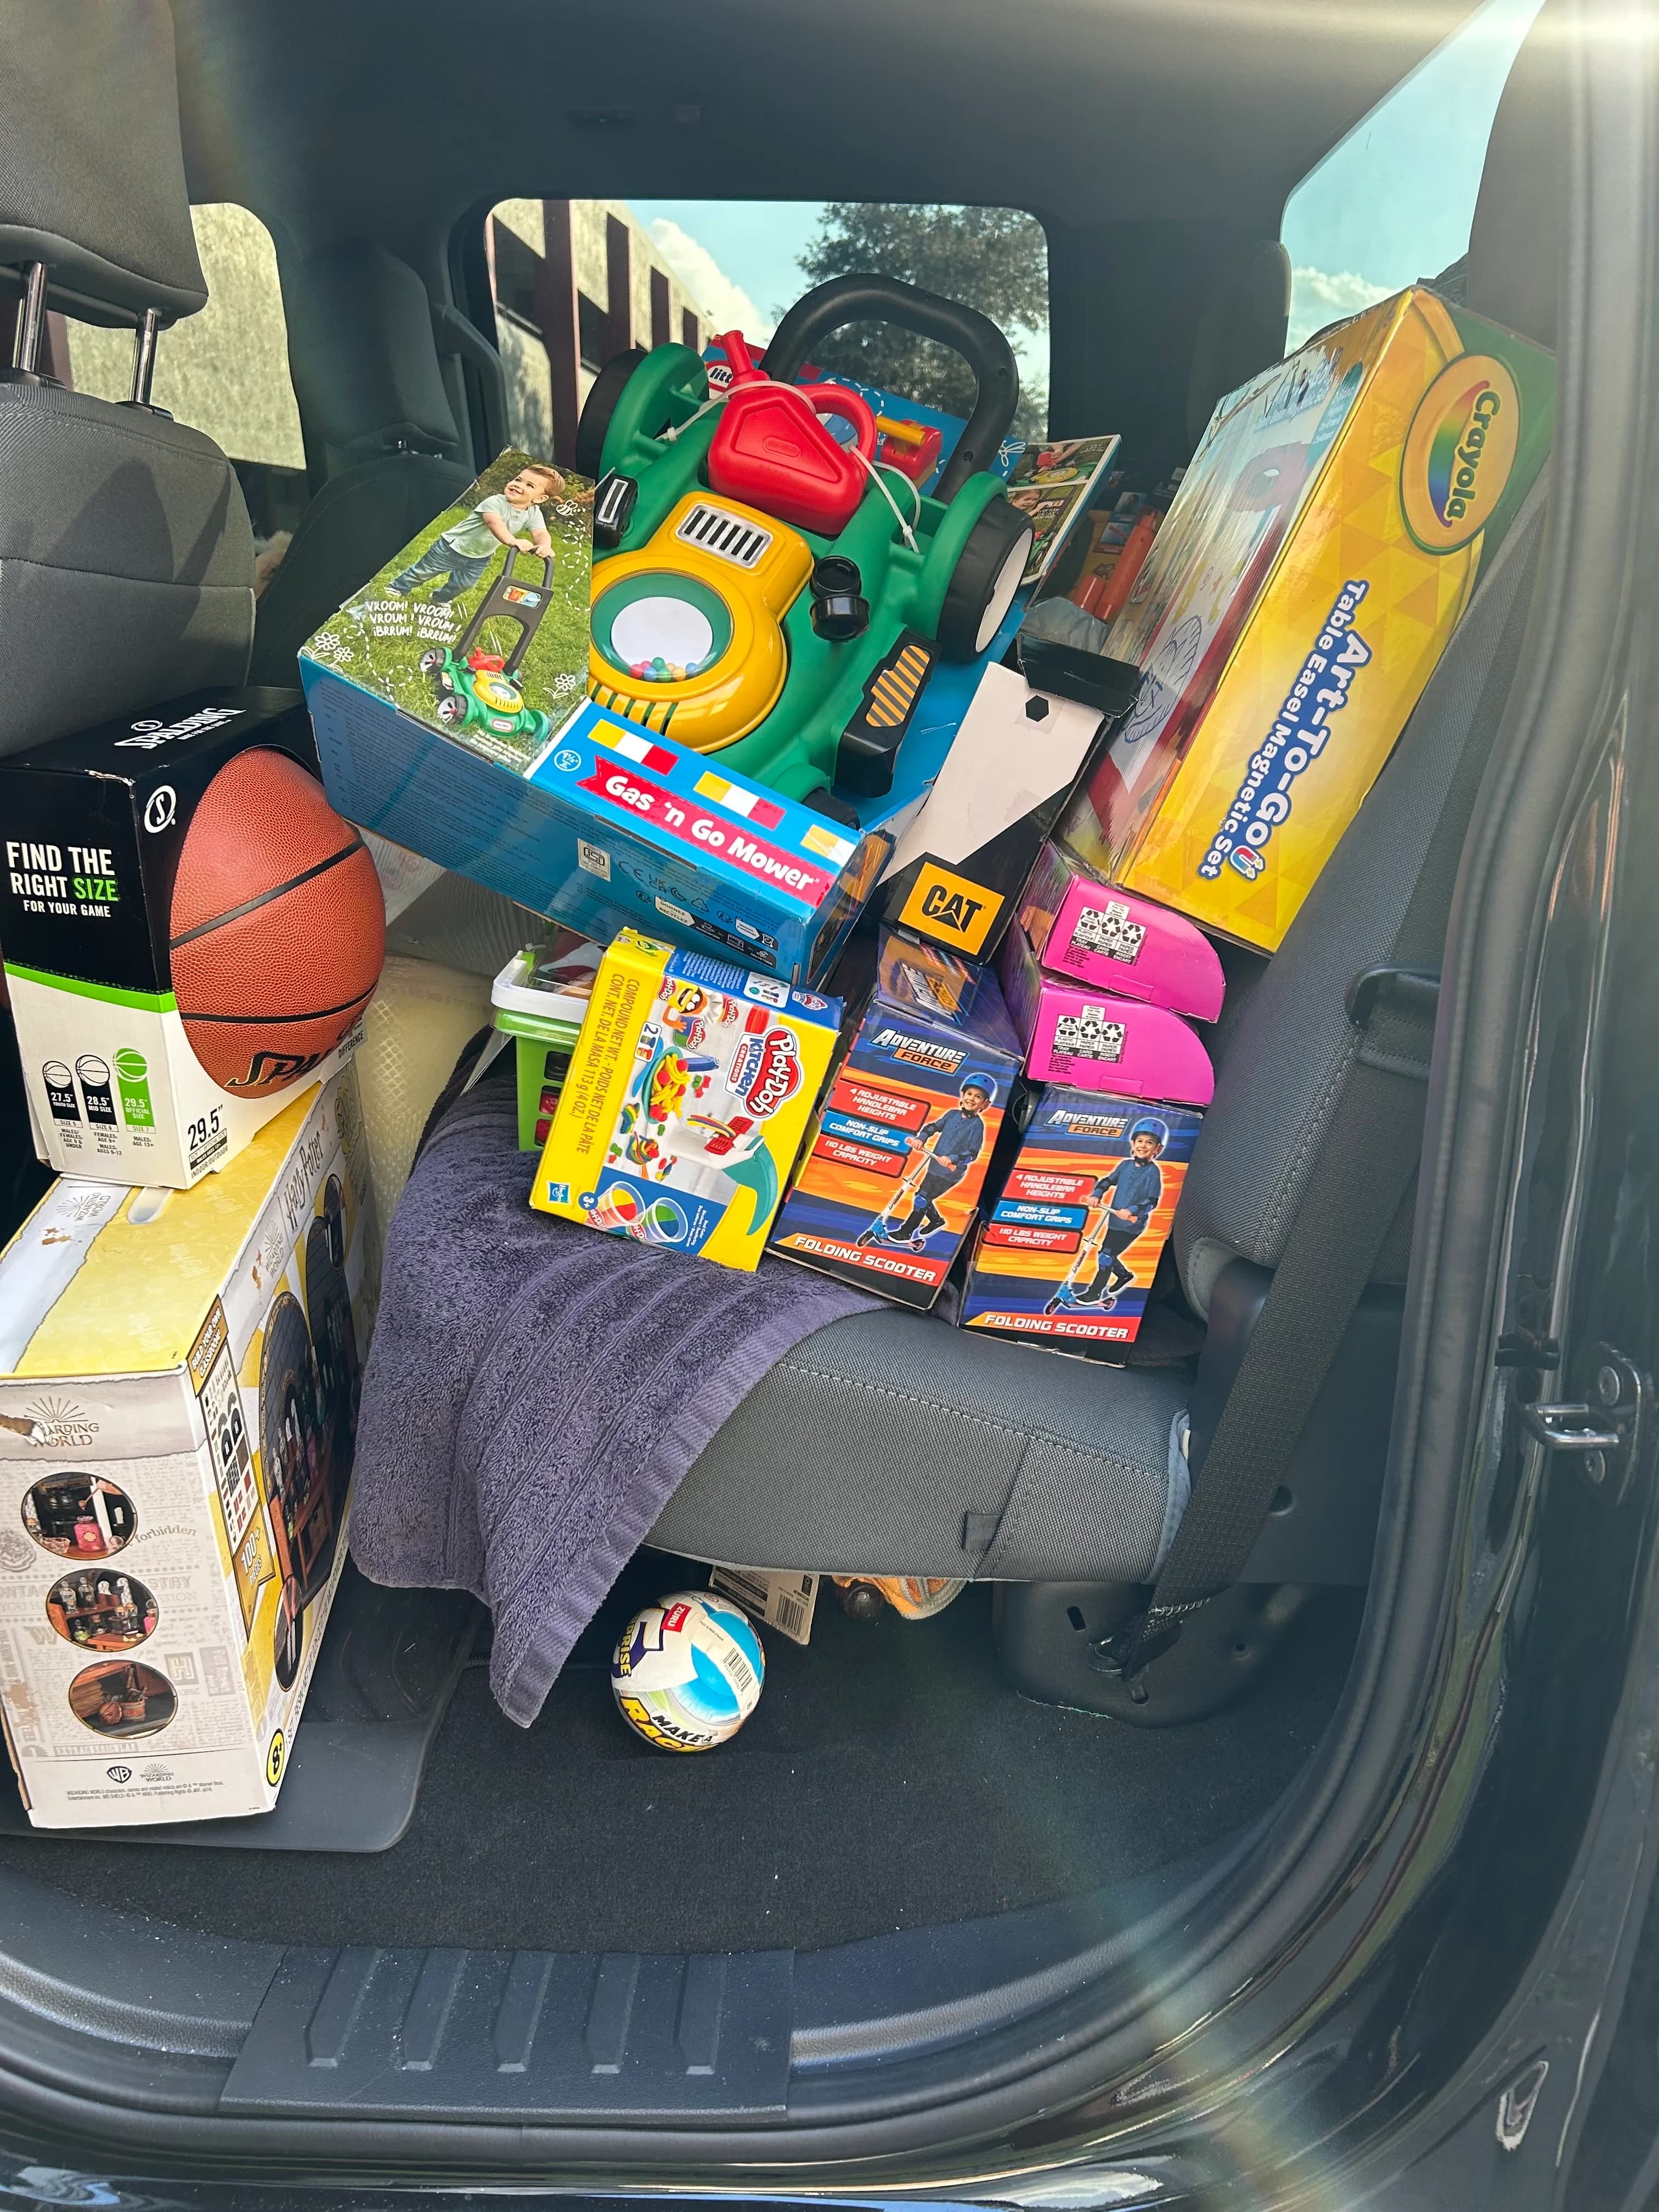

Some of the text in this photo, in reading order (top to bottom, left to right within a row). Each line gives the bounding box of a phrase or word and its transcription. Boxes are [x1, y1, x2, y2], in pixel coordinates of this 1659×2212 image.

[709, 368, 732, 383] litt
[1448, 391, 1501, 519] Crayola
[367, 601, 454, 620] VROOM! VROOM!
[369, 613, 407, 624] VROUM
[419, 614, 455, 632] VROUM
[114, 707, 247, 750] SPALDING
[1200, 583, 1366, 878] Table Easel Magnetic Set
[1244, 632, 1370, 846] Art-To-Go
[605, 775, 655, 811] Gas
[691, 819, 725, 847] Go
[6, 841, 115, 876] FIND THE
[10, 872, 119, 901] RIGHT SIZE
[23, 900, 111, 917] FOR YOUR GAME
[922, 884, 983, 933] CAT
[606, 974, 625, 998] CONT.
[597, 1018, 612, 1031] DE
[644, 1023, 659, 1035] 2
[594, 1031, 608, 1042] LA
[687, 1019, 705, 1050] Play-Doh
[338, 1030, 364, 1059] DIFFERENCE
[872, 1029, 967, 1063] ADVENTURE
[586, 1042, 604, 1068] MASA
[901, 1051, 951, 1070] FORCE
[577, 979, 640, 1154] COMPOUND NET WT. POIDS NET DE LA PÂTE
[749, 1033, 797, 1114] Play-Doh
[582, 1070, 596, 1085] 113
[50, 1092, 73, 1102] 27.5"
[87, 1096, 110, 1106] 28.5"
[125, 1098, 148, 1108] 29.5"
[852, 1096, 908, 1116] HANDLEBAR
[857, 1090, 917, 1111] ADJUSTABLE
[857, 1105, 897, 1120] HEIGHTS
[1047, 1109, 1128, 1128] ADVENTURE
[829, 1122, 900, 1147] COMFORT GRIPS
[845, 1120, 889, 1136] NON-SLIP
[1074, 1126, 1117, 1136] FORCE
[825, 1140, 893, 1163] 110 LBS WEIGHT
[832, 1149, 878, 1166] CAPACITY
[1020, 1181, 1076, 1192] HANDLEBAR
[1024, 1175, 1085, 1186] ADJUSTABLE
[284, 1167, 306, 1234] Harry
[583, 1195, 595, 1208] 3+
[1025, 1189, 1066, 1199] HEIGHTS
[75, 1192, 102, 1221] WIZARDING
[88, 1195, 111, 1217] WORLD
[1017, 1205, 1061, 1215] NON-SLIP
[1001, 1211, 1073, 1224] COMFORT GRIPS
[1008, 1236, 1054, 1246] CAPACITY
[1033, 1231, 1068, 1240] WEIGHT
[794, 1235, 936, 1282] FOLDING SCOOTER
[984, 1314, 1128, 1339] FOLDING SCOOTER
[35, 1434, 93, 1448] ORLD
[135, 1525, 196, 1543] forbidden
[241, 1526, 261, 1576] 100+
[667, 1605, 686, 1627] ZURU
[652, 1715, 706, 1743] MAKE
[108, 1767, 132, 1782] WB
